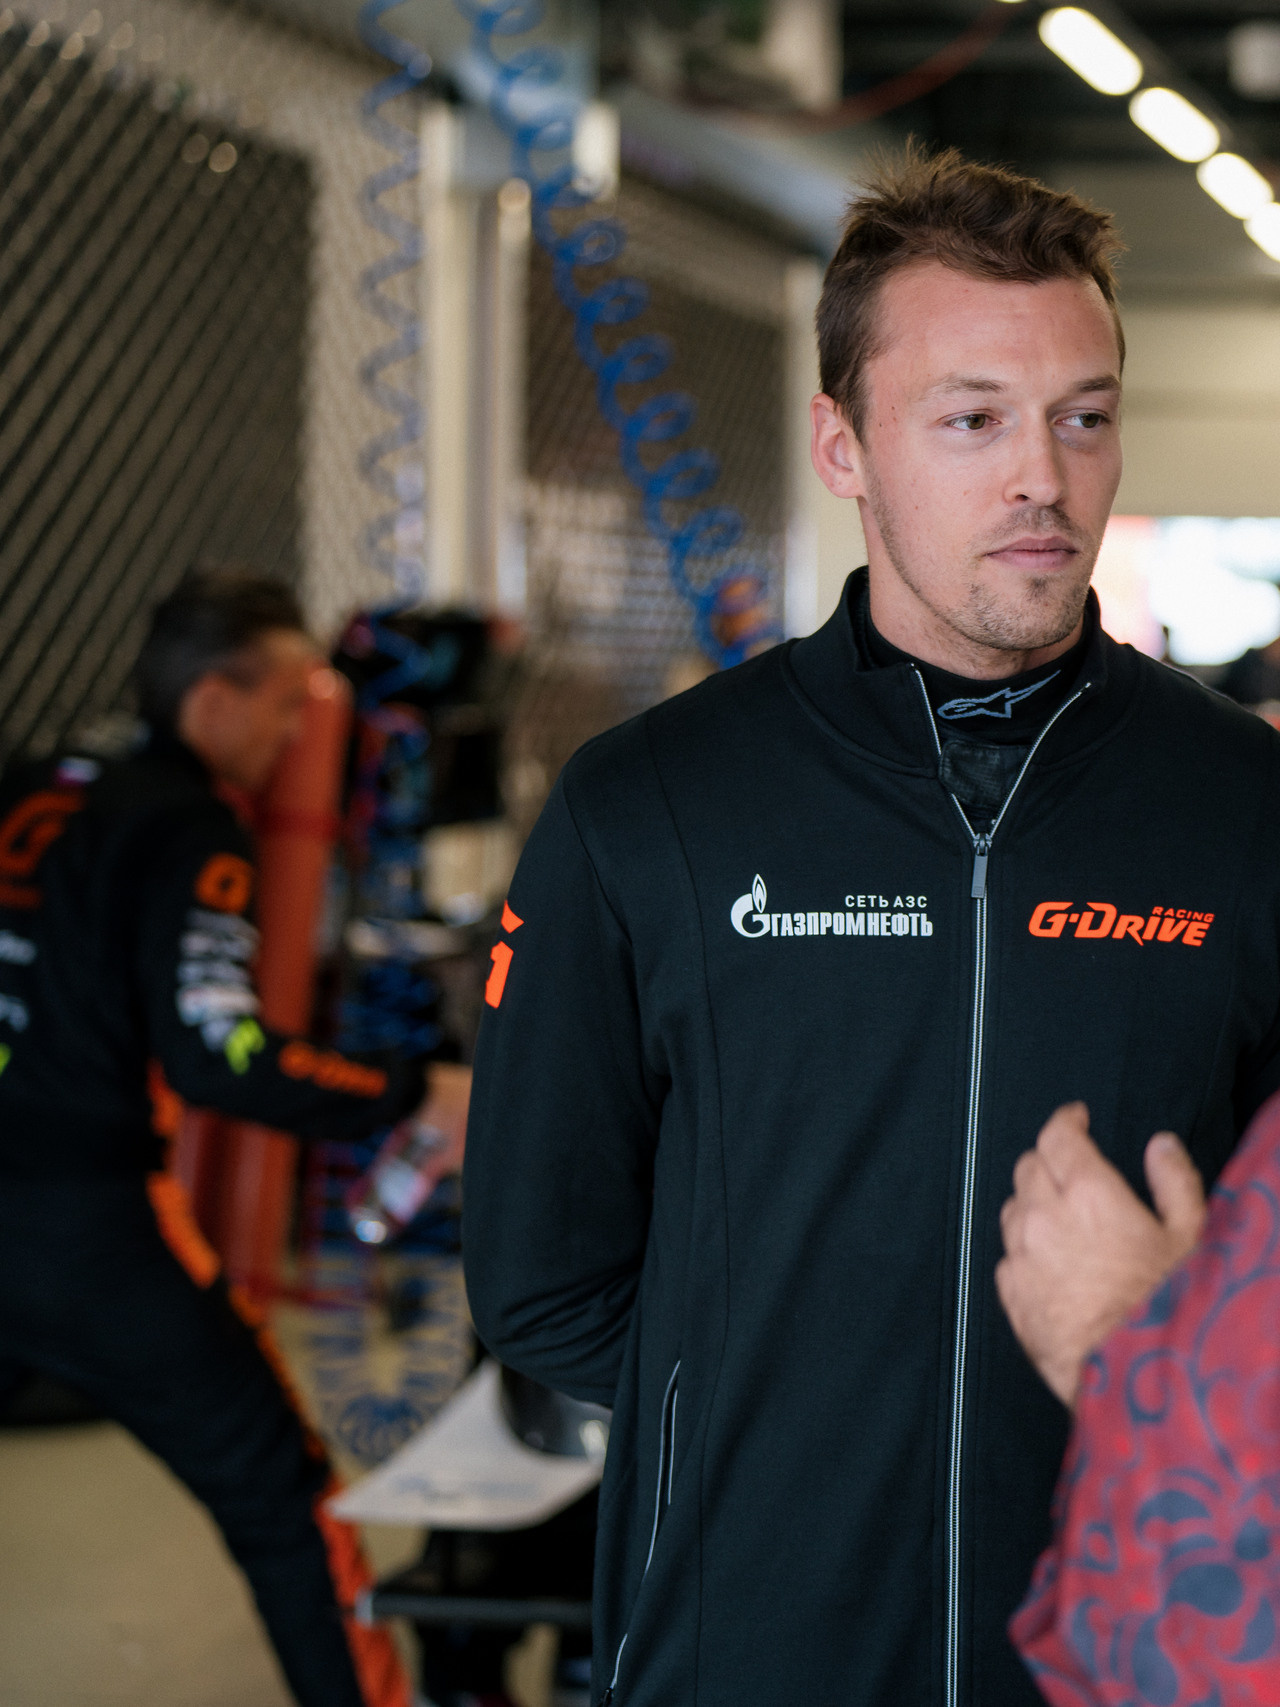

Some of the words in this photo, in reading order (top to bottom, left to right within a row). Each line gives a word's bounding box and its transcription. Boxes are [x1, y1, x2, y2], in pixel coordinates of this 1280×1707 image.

[845, 895, 889, 908] СЕТЬ
[893, 896, 928, 908] АЗС
[1152, 906, 1215, 923] RACING
[770, 912, 933, 937] ГАЗПРОМНЕФТЬ
